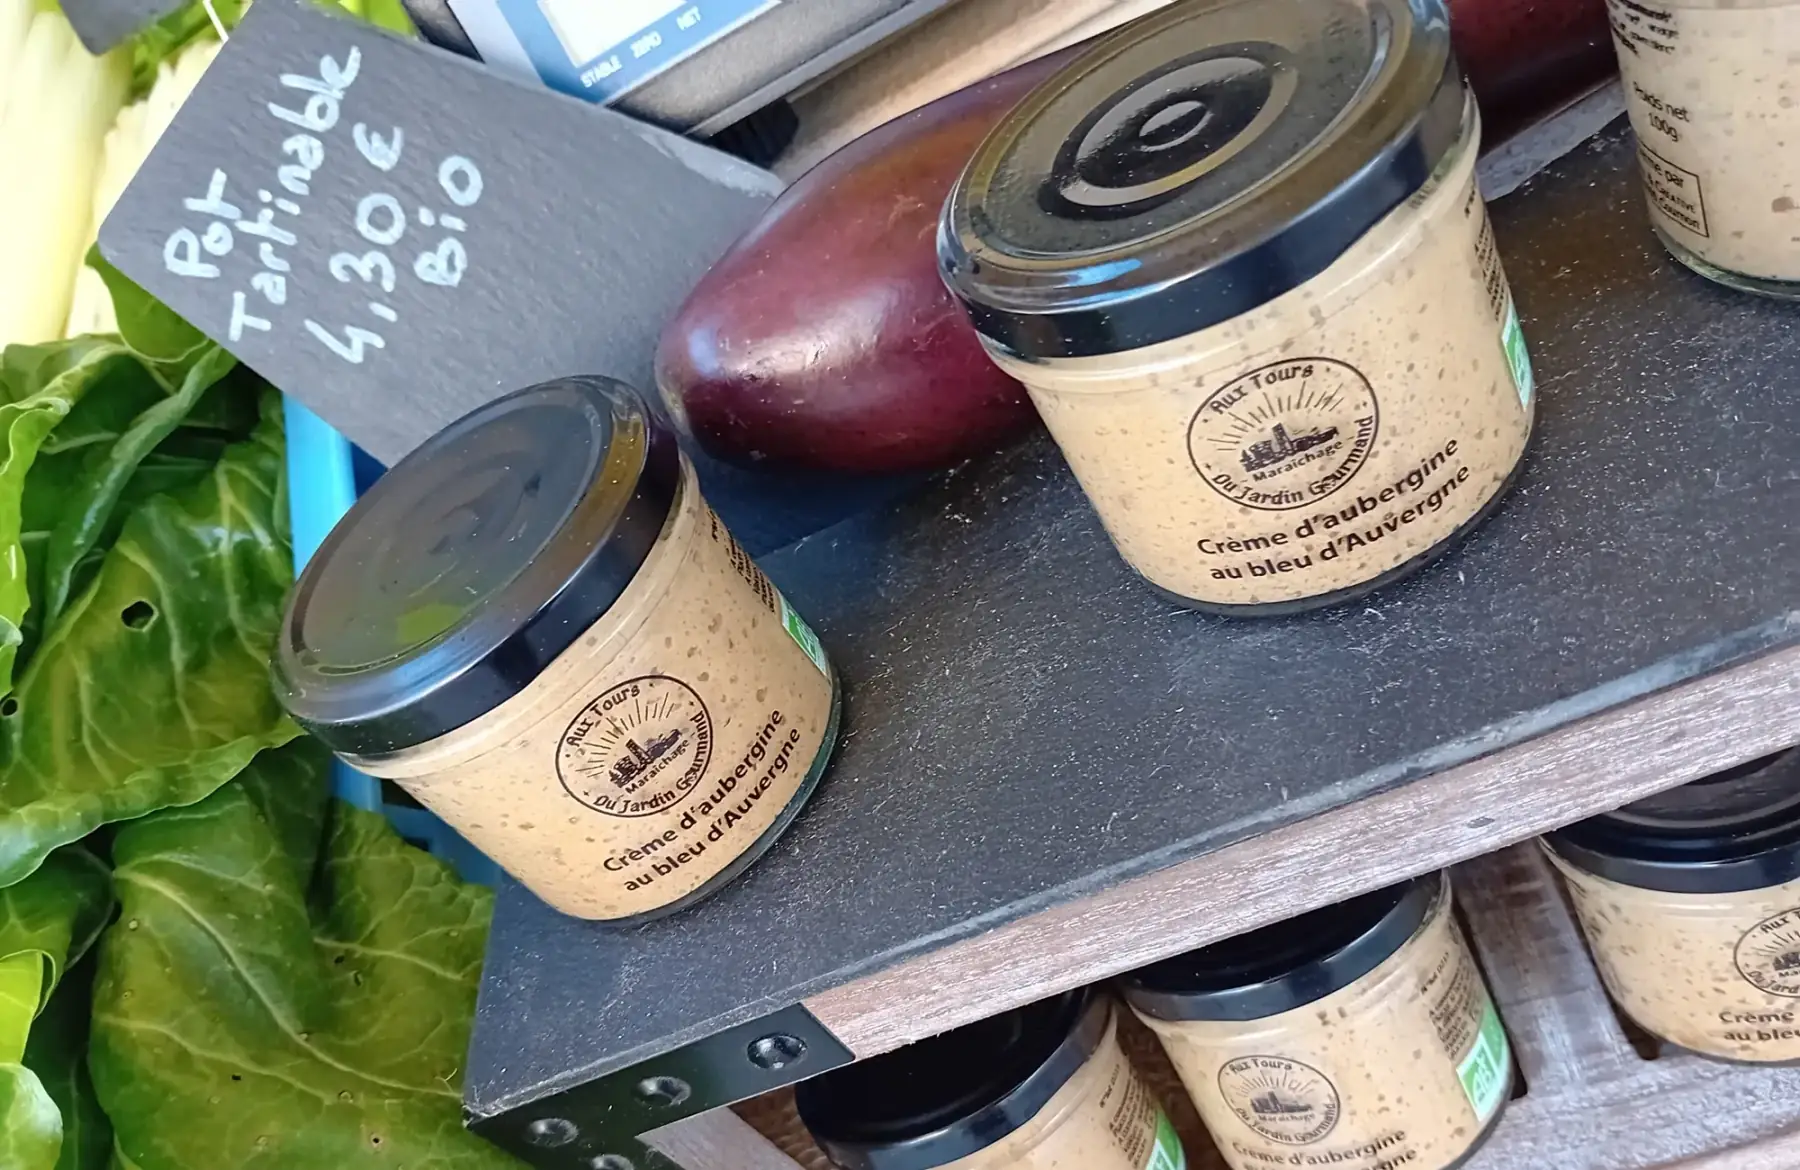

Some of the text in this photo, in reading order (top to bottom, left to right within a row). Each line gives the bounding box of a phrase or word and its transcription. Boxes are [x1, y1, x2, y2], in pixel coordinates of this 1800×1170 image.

[580, 55, 622, 88] STABLE
[676, 6, 701, 31] NET
[1648, 112, 1679, 142] 100g
[1666, 103, 1690, 122] net
[163, 168, 242, 278] Pot
[228, 45, 362, 341] Tartinable
[413, 155, 483, 287] Bio
[1209, 363, 1314, 414] Aux Tours
[1211, 414, 1375, 507] Du Jardin Gourmand
[1252, 440, 1343, 482] Maraîchage
[1197, 438, 1459, 556] Crème d'aubergine
[1210, 463, 1471, 580] au bleu d'Auvergne
[566, 683, 641, 748] Aux Tours
[593, 710, 710, 814] Du Jardin Gourmand
[603, 709, 784, 872] Crème d'aubergine
[626, 739, 690, 795] Maraîchage
[623, 727, 801, 891] au bleu d'Auvergne
[1760, 916, 1790, 933] Aux
[1719, 1011, 1794, 1023] Crème
[1724, 1030, 1750, 1041] au
[1251, 1058, 1293, 1071] Tours
[1235, 1107, 1250, 1121] Du
[1251, 1120, 1292, 1142] Jardin
[1289, 1128, 1407, 1166] d'aubergine
